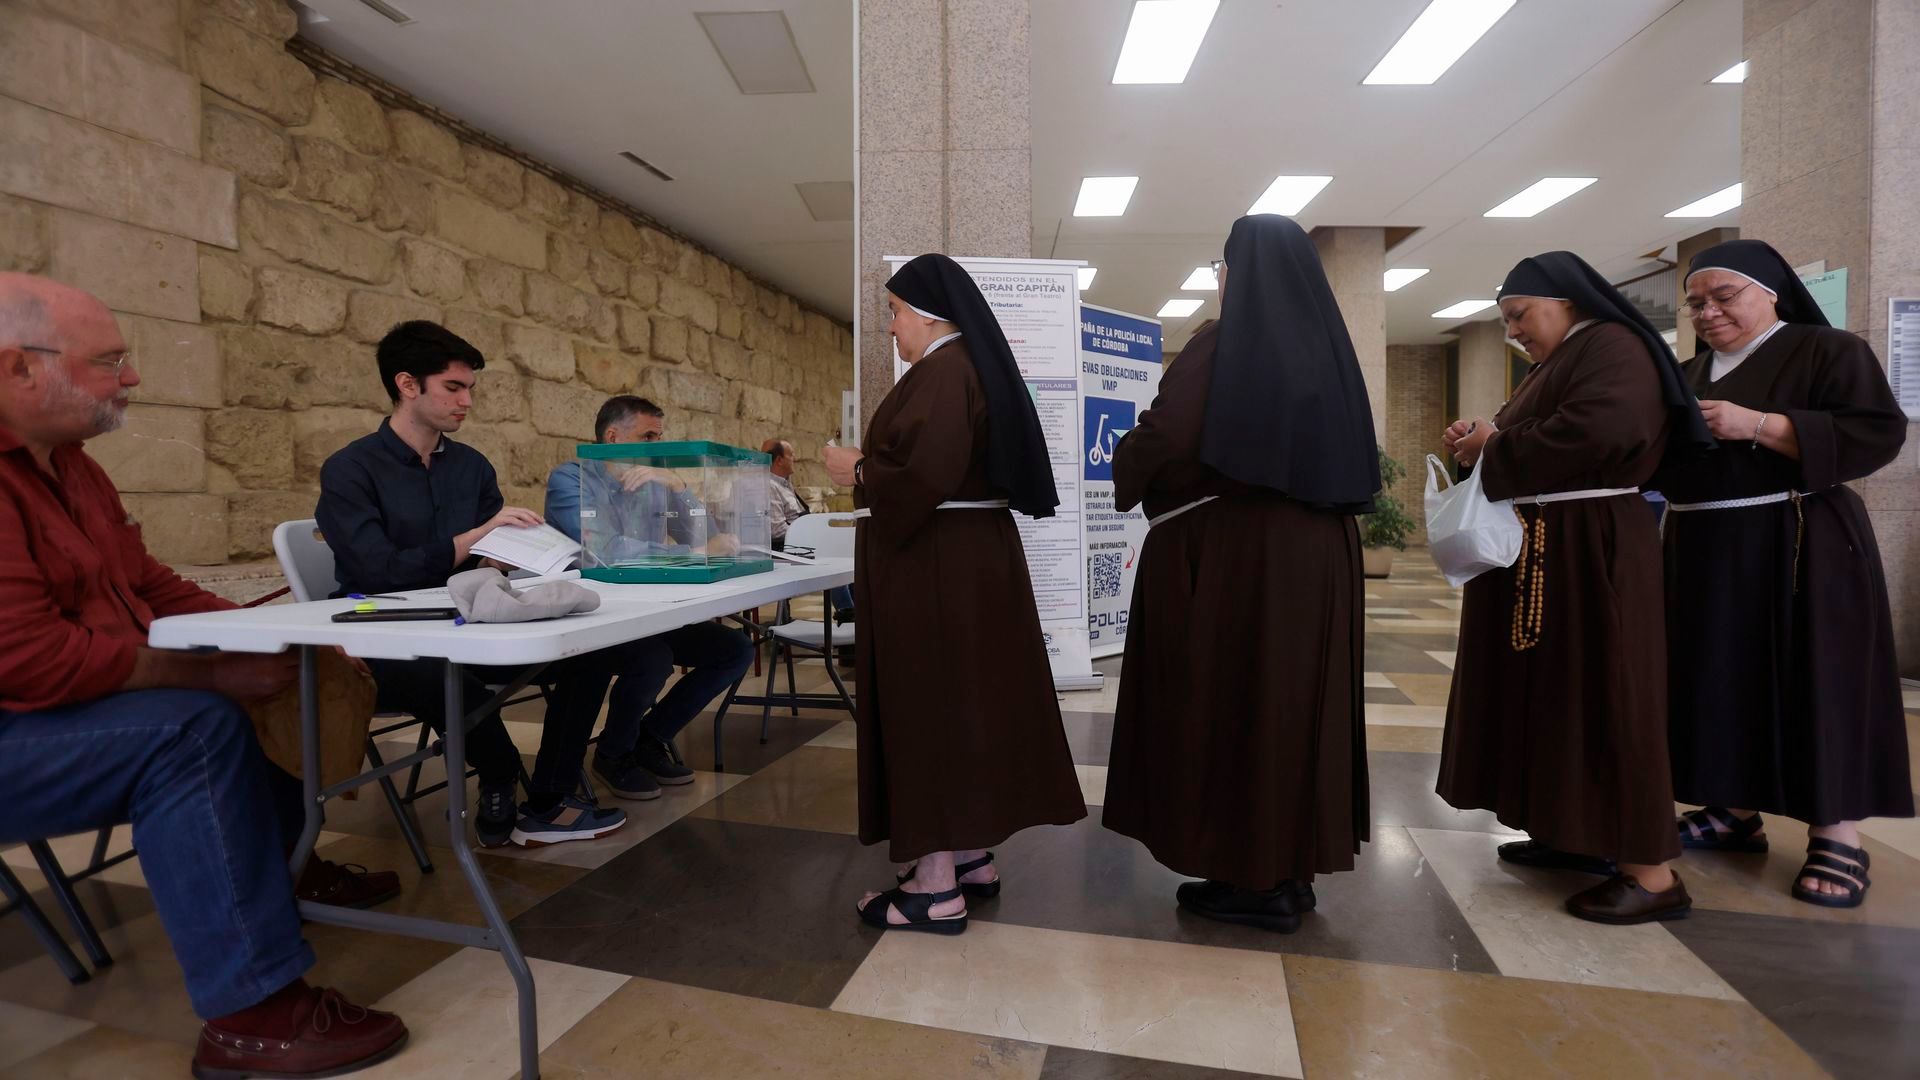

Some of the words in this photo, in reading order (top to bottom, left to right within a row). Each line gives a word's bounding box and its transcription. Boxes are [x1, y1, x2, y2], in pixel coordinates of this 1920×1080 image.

[980, 283, 1013, 292] GRAN
[1016, 283, 1065, 293] CAPITÁN
[1096, 326, 1105, 336] DE
[1105, 328, 1113, 338] LA
[1114, 329, 1135, 342] POLICÍA
[1136, 334, 1153, 346] LOCAL
[1092, 337, 1101, 348] DE
[1102, 338, 1129, 353] CÓRDOBA
[1082, 361, 1099, 375] EVAS
[1100, 364, 1148, 382] OBLIGACIONES
[1102, 379, 1118, 391] VMP
